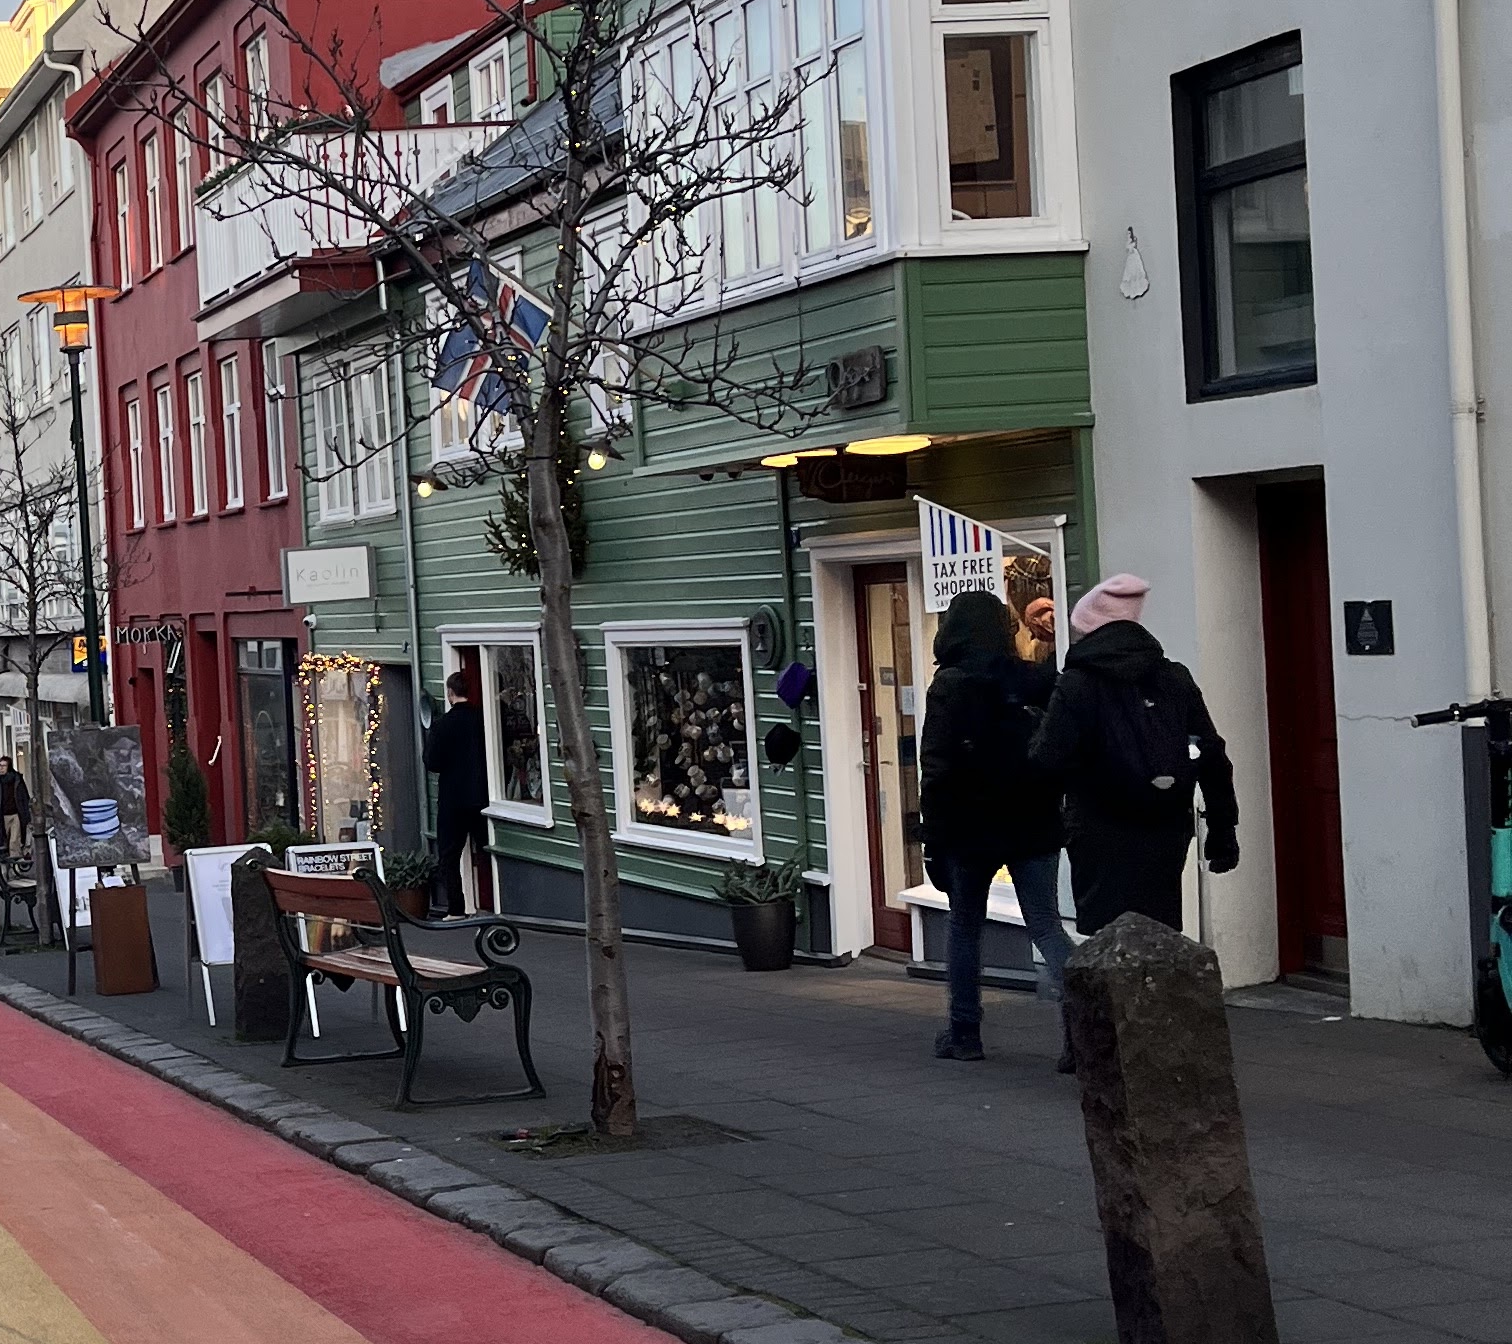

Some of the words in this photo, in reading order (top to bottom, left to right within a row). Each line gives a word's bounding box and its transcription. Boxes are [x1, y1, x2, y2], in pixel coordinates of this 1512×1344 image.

[296, 562, 359, 583] Kaolin
[932, 560, 957, 579] TAX
[962, 557, 994, 576] FREE
[933, 576, 996, 597] SHOPPING
[115, 624, 177, 645] MOKKA
[296, 854, 340, 866] RAINBOW
[339, 851, 374, 863] STREET
[297, 862, 346, 873] BRACELETS
